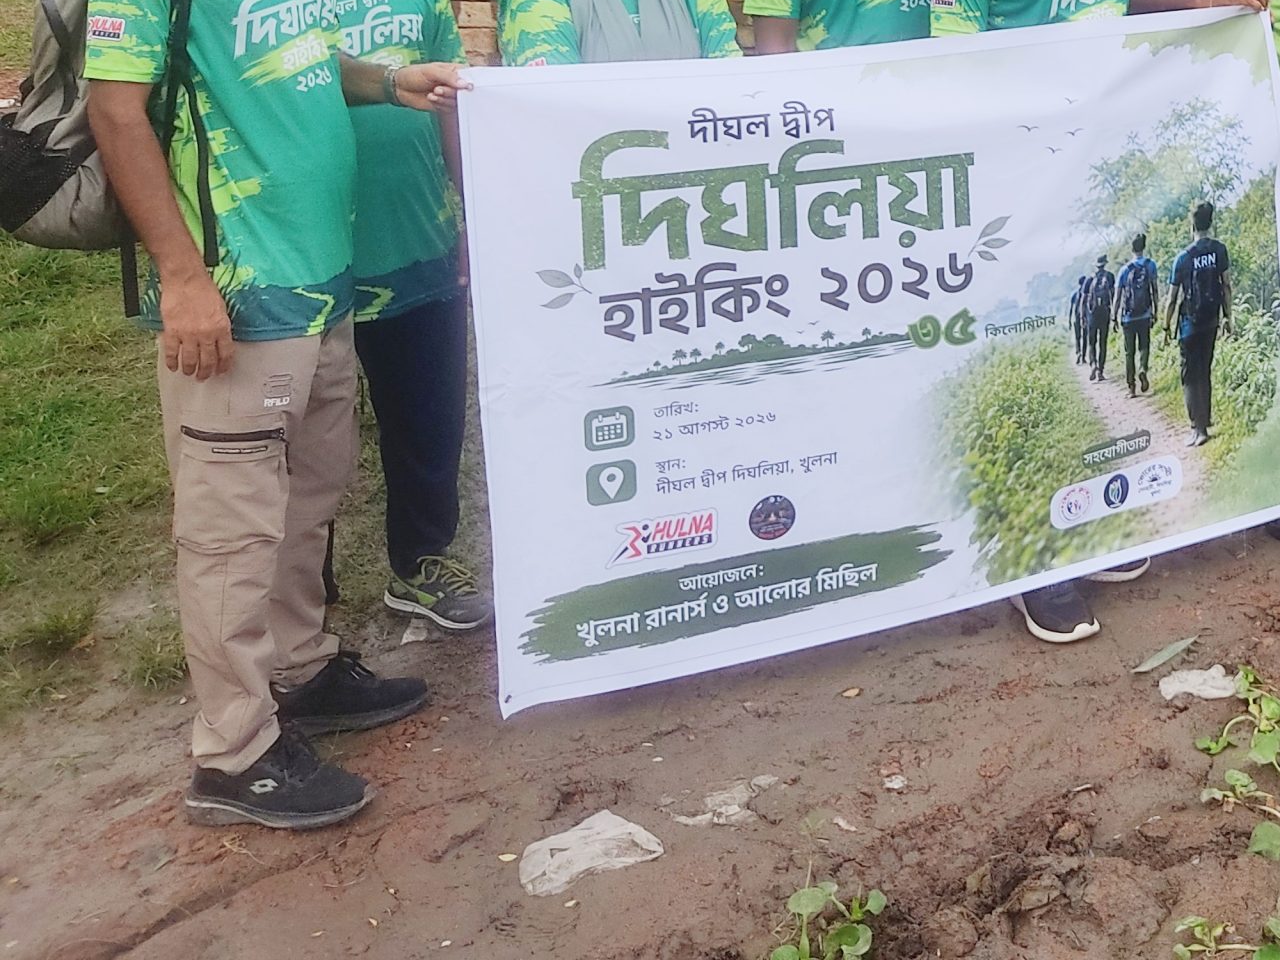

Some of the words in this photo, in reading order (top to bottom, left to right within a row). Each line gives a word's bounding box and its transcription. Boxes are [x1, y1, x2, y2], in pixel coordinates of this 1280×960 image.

[688, 107, 770, 143] দীঘল
[779, 101, 836, 139] দ্বীপ
[571, 129, 975, 271] দিঘলিয়া
[1193, 252, 1217, 270] KRN
[599, 262, 791, 342] হাইকিং
[820, 253, 974, 311] ২০২৬
[908, 308, 978, 349] ৩৫
[984, 314, 1058, 340] কিলোমিটার
[653, 400, 699, 420] তারিখ:
[653, 427, 673, 441] ২১
[678, 415, 731, 438] আগস্ট
[735, 411, 776, 428] ২০২৬
[656, 457, 686, 475] স্থান:
[656, 474, 696, 495] দীঘল
[700, 469, 727, 489] দ্বীপ
[732, 458, 795, 483] দিঘলিয়া,
[799, 451, 839, 474] খুলনা
[678, 563, 765, 592] আয়োজনে:
[575, 612, 640, 647] খুলনা
[645, 593, 706, 631] রানার্স
[711, 597, 730, 615] ও
[734, 575, 812, 609] আলোর
[815, 563, 879, 593] মিছিল
